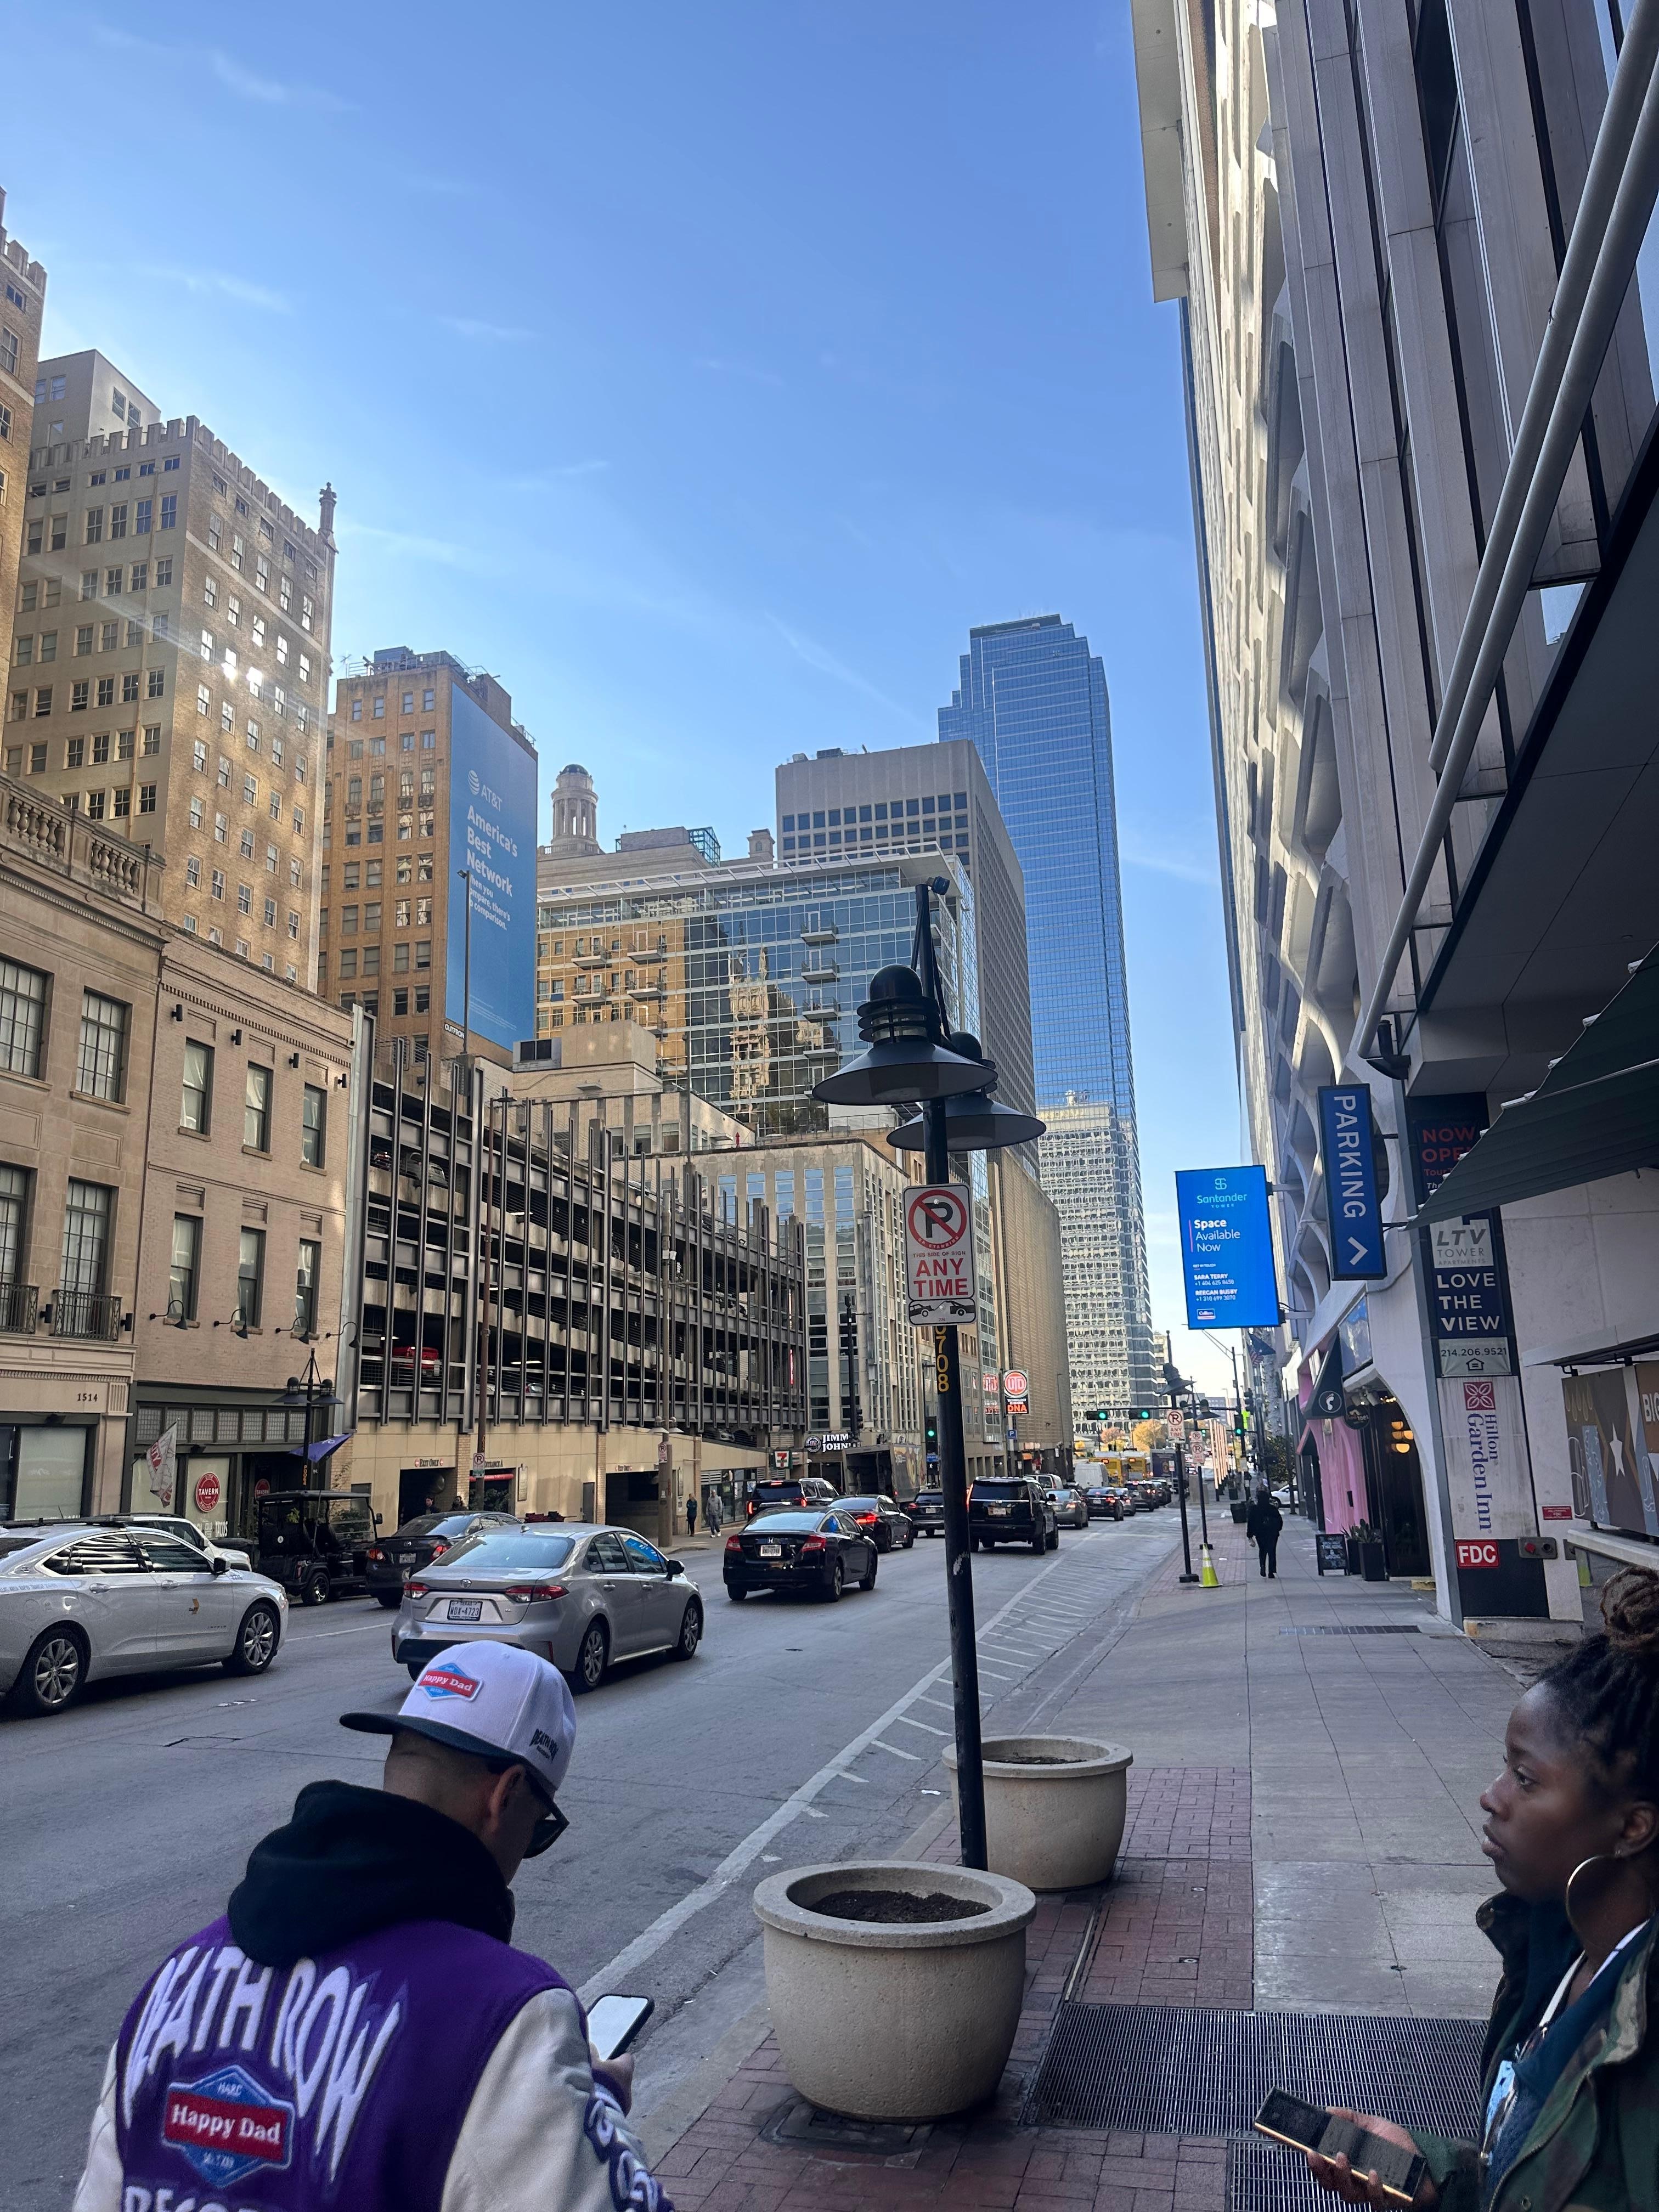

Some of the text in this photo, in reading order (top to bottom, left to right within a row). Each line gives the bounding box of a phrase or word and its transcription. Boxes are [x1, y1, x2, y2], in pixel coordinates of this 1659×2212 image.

[481, 785, 503, 812] AT&T
[467, 805, 518, 857] America's
[467, 826, 492, 859] Best
[467, 848, 513, 898] Network
[470, 874, 494, 898] hen you
[469, 887, 511, 922] ompare, there's
[474, 902, 507, 931] comparison.
[444, 1023, 465, 1039] OUTFRON
[1422, 1127, 1475, 1143] NOW
[1334, 1095, 1366, 1218] PARKING
[1422, 1147, 1471, 1163] OPE
[1197, 1193, 1248, 1204] Santander
[1194, 1219, 1227, 1231] Space
[1195, 1228, 1240, 1240] Available
[1436, 1228, 1487, 1246] LTV
[1197, 1243, 1221, 1252] Now
[1437, 1247, 1485, 1258] TOWER
[916, 1257, 964, 1277] ANY
[913, 1278, 969, 1298] TIME
[1436, 1272, 1496, 1289] LOVE
[1438, 1295, 1482, 1310] THE
[1441, 1315, 1500, 1331] VIEW
[1441, 1347, 1507, 1357] 214.206.9521
[77, 1393, 98, 1402] 1514
[1007, 1404, 1027, 1412] DNA
[822, 1434, 849, 1443] JIMM
[1484, 1414, 1499, 1459] Hilton
[822, 1442, 851, 1453] JOHN'
[1467, 1413, 1493, 1531] Garden Inn
[199, 1487, 219, 1496] TAVERN
[215, 1521, 228, 1537] TACOS
[1458, 1544, 1497, 1564] FDC
[423, 1675, 449, 1684] Happy
[450, 1678, 473, 1691] Dad
[123, 1945, 274, 2130] DEATH
[271, 1956, 401, 2183] ROW
[171, 2103, 281, 2146] Happy Dad
